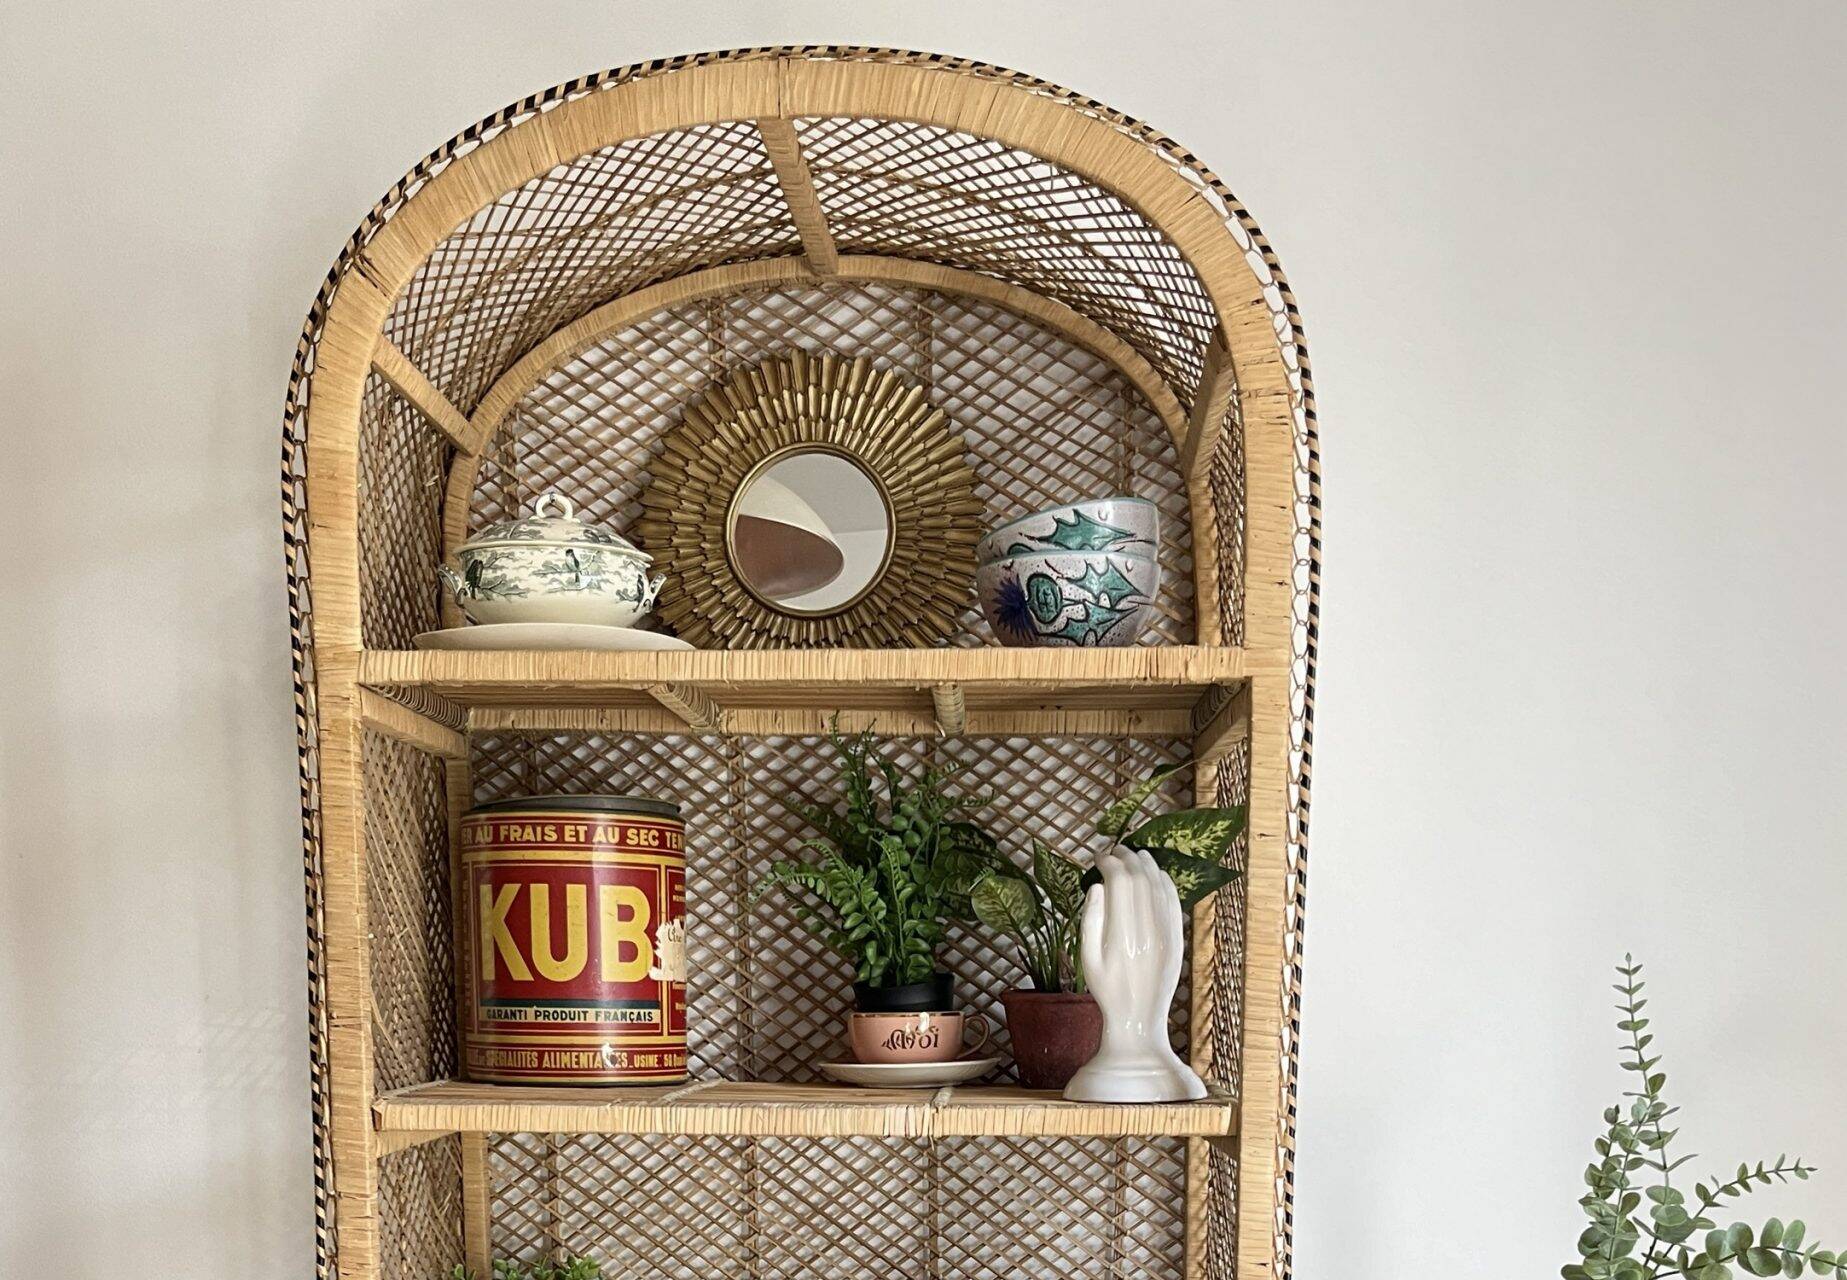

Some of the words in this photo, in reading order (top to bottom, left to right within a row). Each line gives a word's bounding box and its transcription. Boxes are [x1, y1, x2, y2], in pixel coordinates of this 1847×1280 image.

[475, 825, 493, 844] AU
[500, 824, 558, 843] FRAIS
[564, 824, 588, 843] ET
[592, 826, 620, 844] AU
[626, 828, 660, 847] SEC
[480, 883, 653, 983] KUB
[486, 1009, 528, 1019] GARANTI
[534, 1010, 589, 1021] PRODUIT
[595, 1010, 654, 1023] FRANÇAIS
